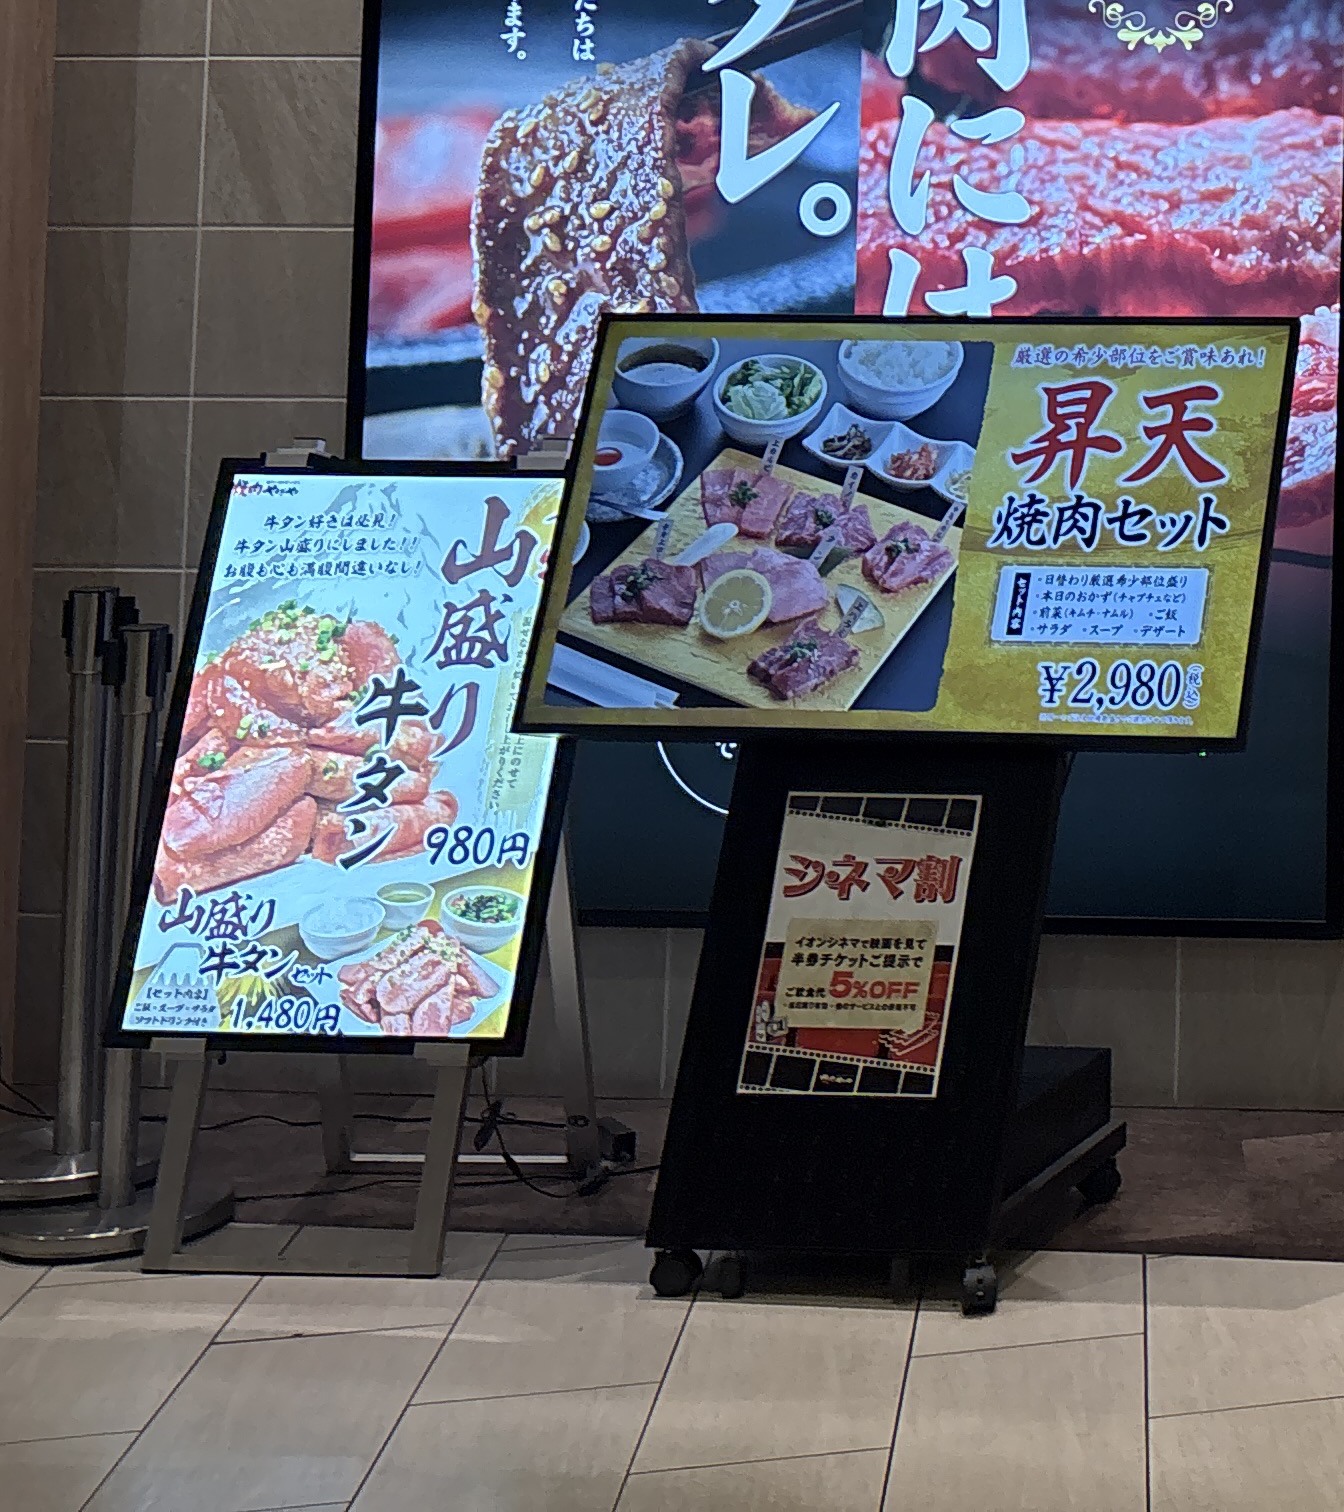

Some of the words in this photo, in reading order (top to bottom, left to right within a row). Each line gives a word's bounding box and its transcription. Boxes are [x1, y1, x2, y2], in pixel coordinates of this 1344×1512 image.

[1009, 380, 1228, 489] 昇天
[988, 494, 1230, 550] 焼肉セット
[424, 495, 540, 760] 山盛り
[339, 667, 430, 872] 牛タン
[423, 825, 533, 868] 980円
[781, 852, 963, 904] シネマ割
[159, 887, 277, 941] 山盛り
[230, 996, 342, 1032] 1,480円
